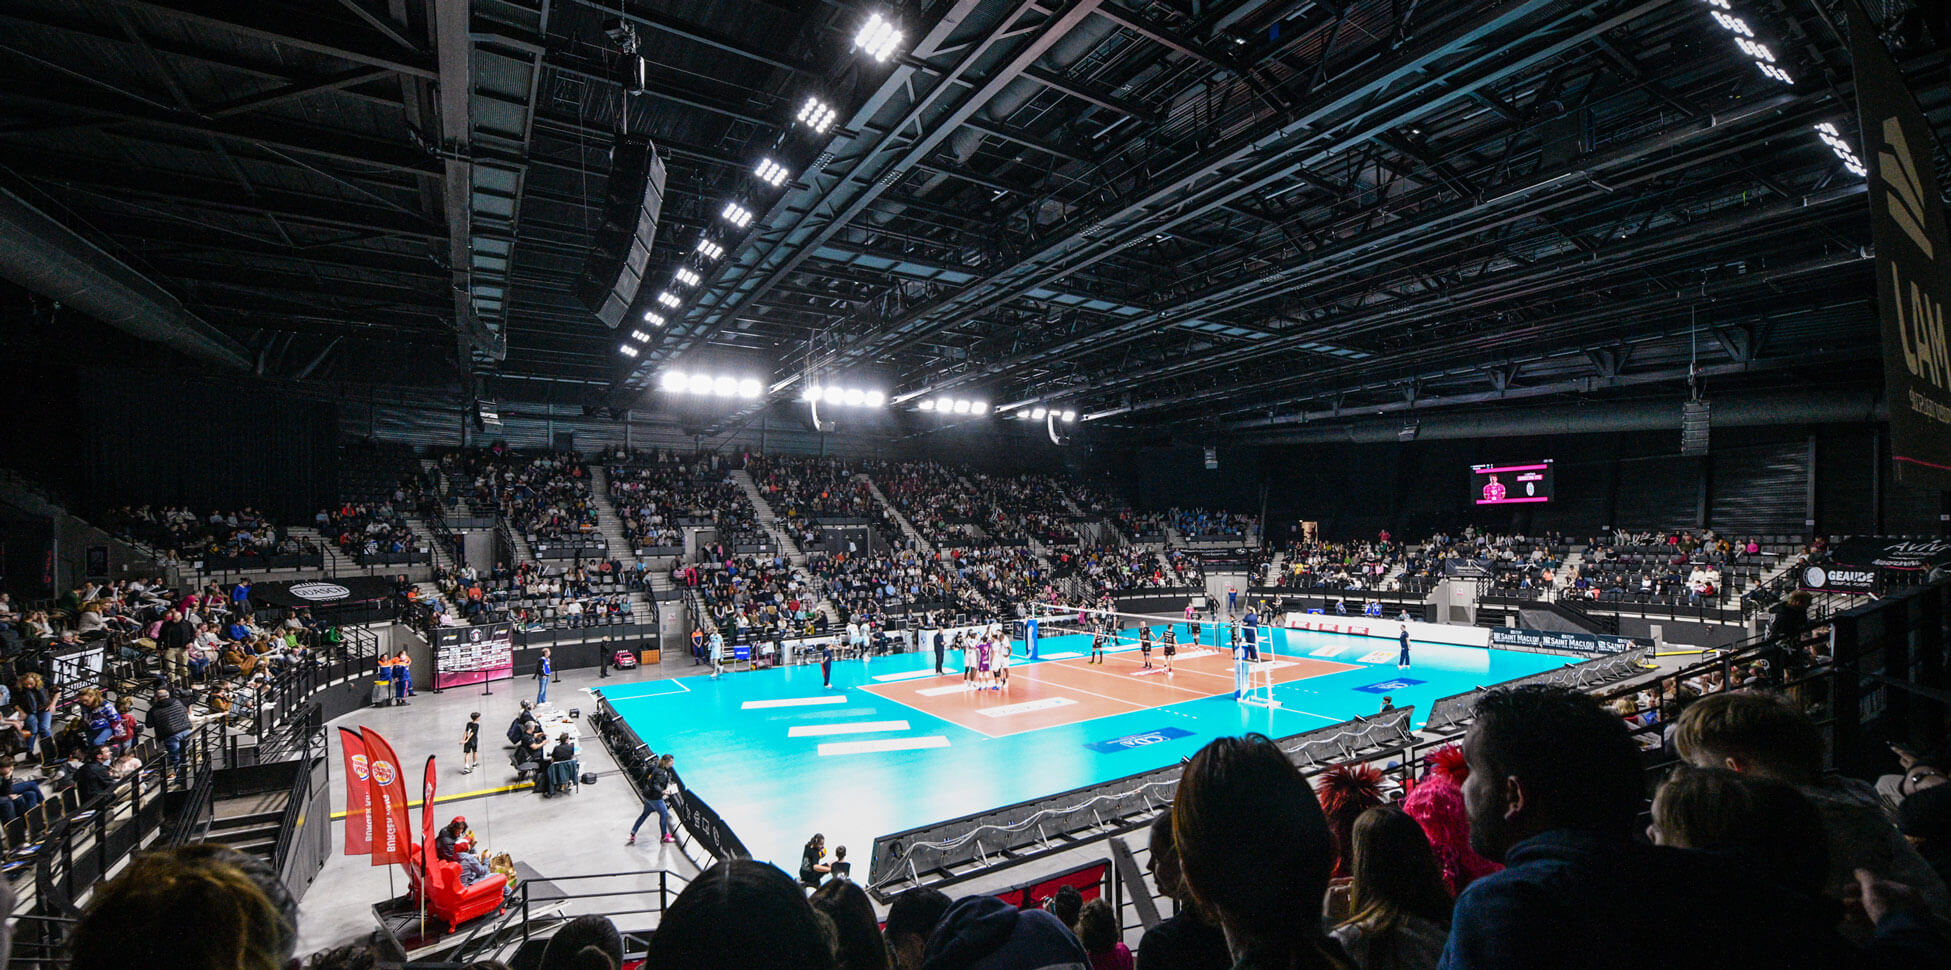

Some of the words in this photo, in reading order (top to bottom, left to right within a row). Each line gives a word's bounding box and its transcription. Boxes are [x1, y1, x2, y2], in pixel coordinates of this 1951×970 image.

[1827, 570, 1876, 583] GEAUDE
[1500, 633, 1517, 642] SAINT
[1517, 634, 1540, 644] MACLOU
[1550, 637, 1569, 647] SAINT
[1569, 639, 1595, 649] MACLOU
[1606, 642, 1626, 652] SAINT
